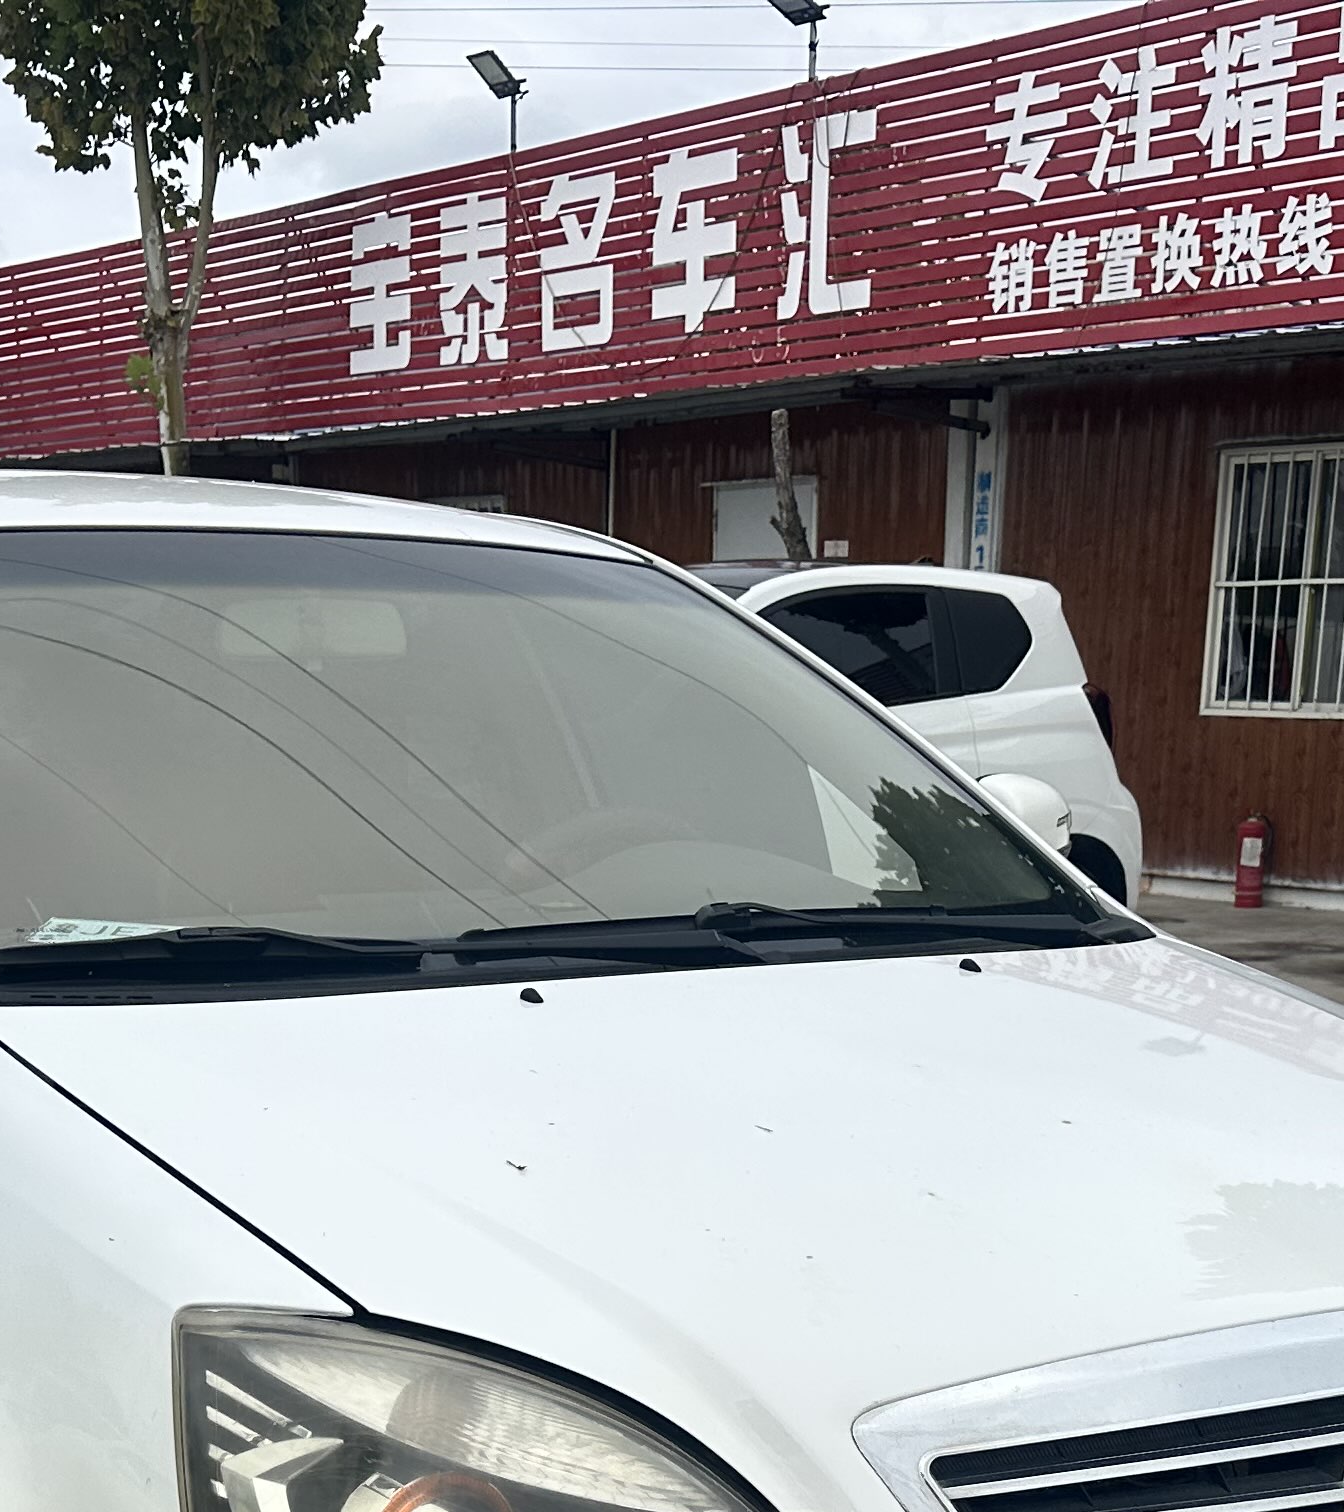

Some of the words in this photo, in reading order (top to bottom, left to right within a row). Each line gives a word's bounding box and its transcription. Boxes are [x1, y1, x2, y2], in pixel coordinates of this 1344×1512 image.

[349, 109, 876, 375] 宝泰名车汇
[986, 194, 1333, 315] 销售置换热线
